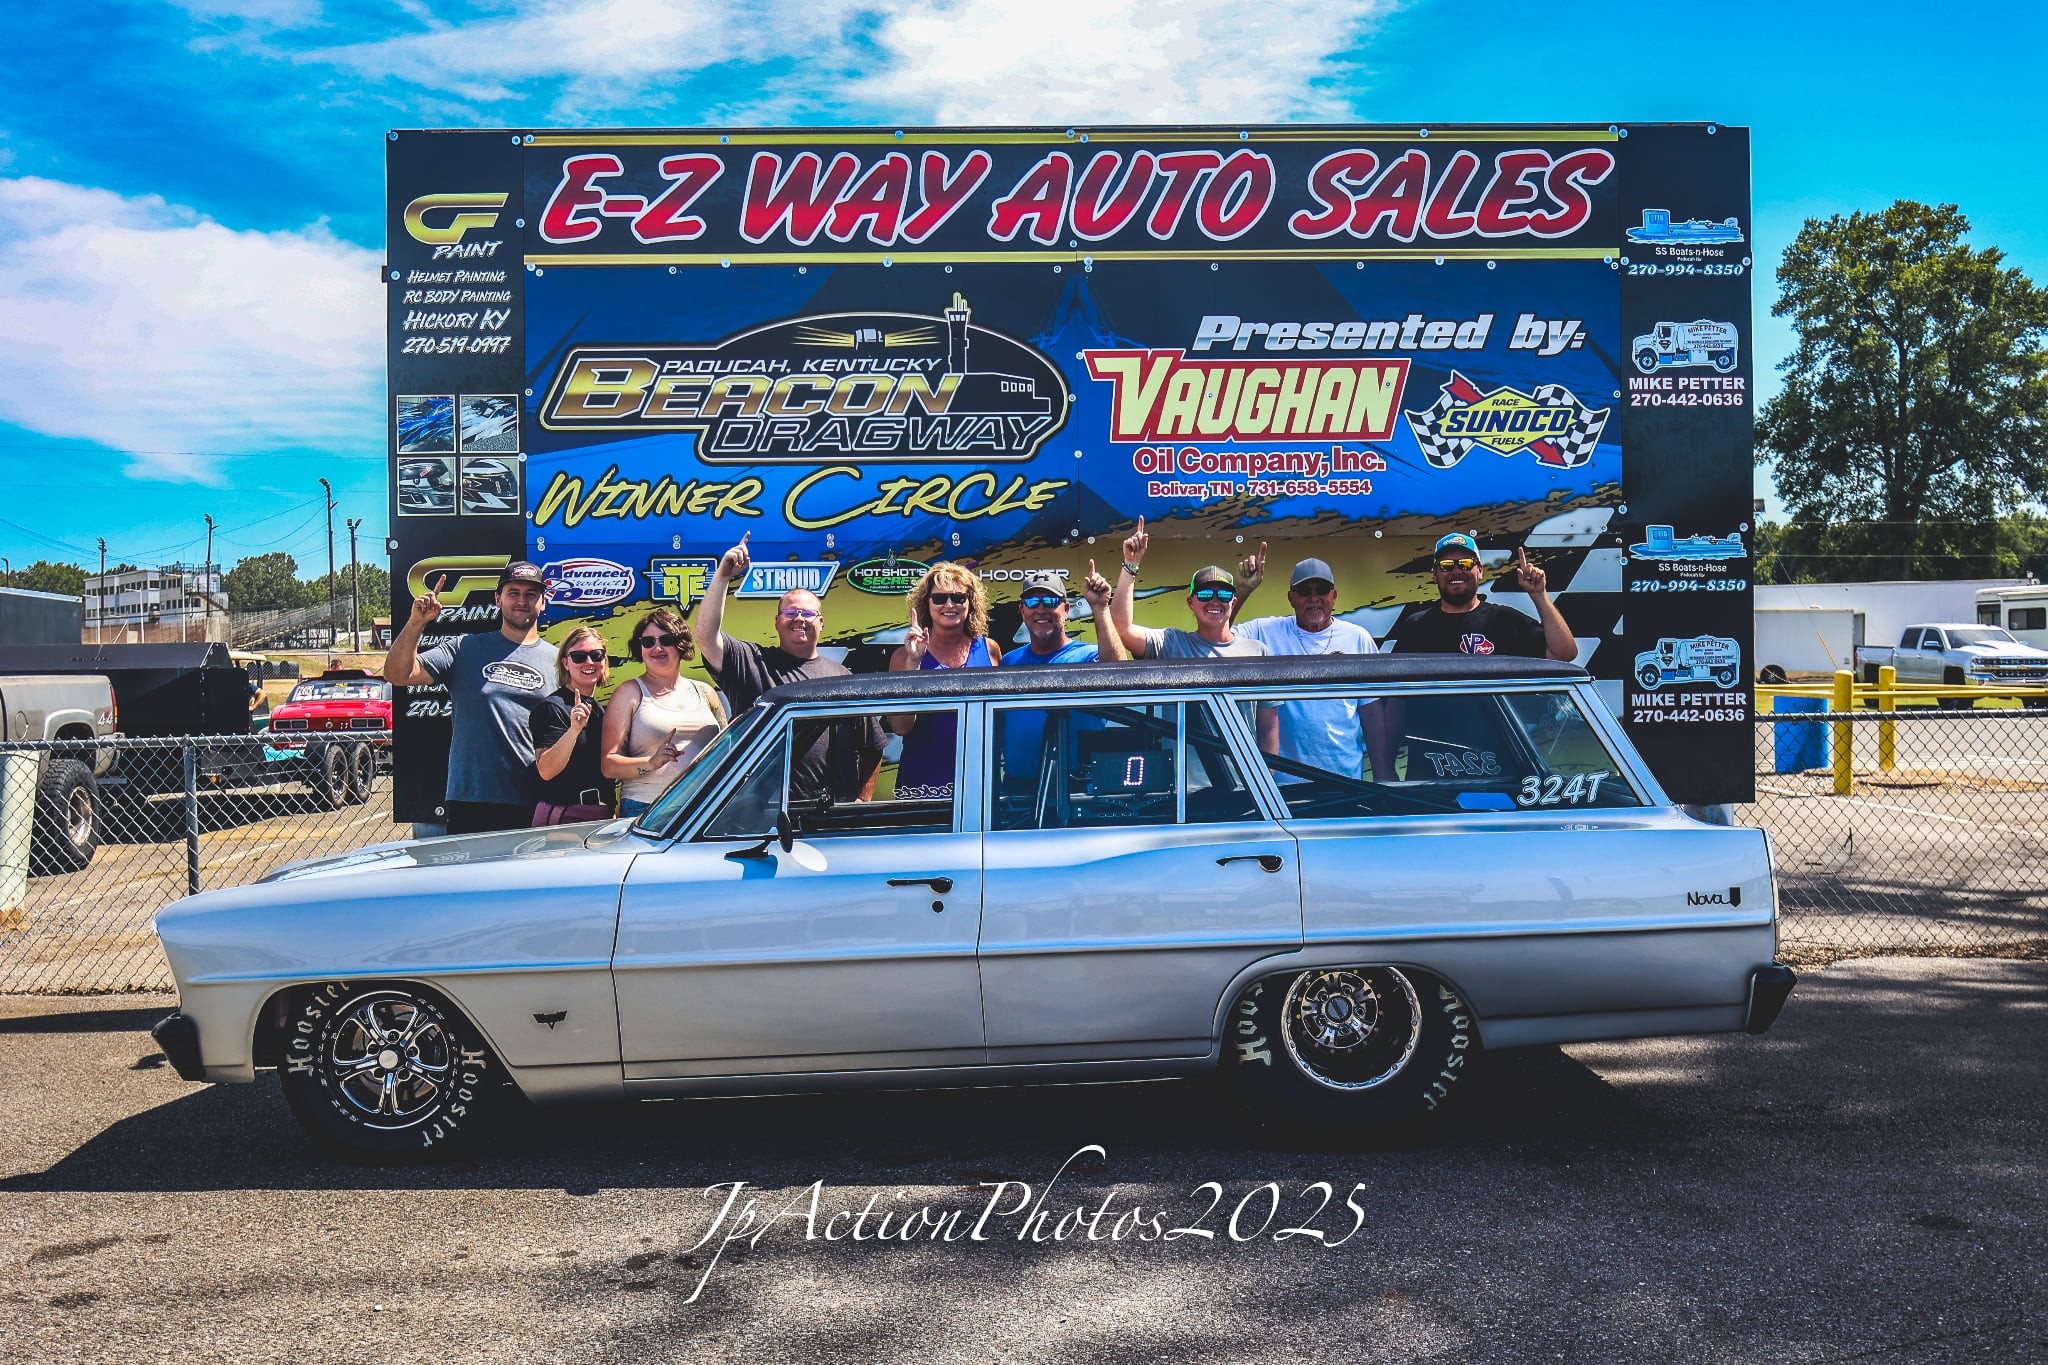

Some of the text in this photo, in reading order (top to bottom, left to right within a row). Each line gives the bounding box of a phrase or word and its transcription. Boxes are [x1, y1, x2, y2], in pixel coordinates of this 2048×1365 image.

[538, 148, 1615, 246] E-Z WAY AUTO SALES
[432, 241, 504, 260] PAINT
[1655, 247, 1724, 257] SS Boats-n-Hose
[1627, 263, 1744, 275] 270-994-8350
[403, 289, 422, 304] RC
[480, 307, 511, 331] KY
[1192, 313, 1587, 356] Presented by:
[401, 336, 512, 354] 270-519-0997
[662, 357, 941, 374] PADUCAH, KENTUCKY
[551, 357, 964, 419] BEACON
[1629, 377, 1745, 390] MIKE PETTER
[1090, 354, 1405, 437] VAUGHAN
[1492, 398, 1520, 406] RACE
[1630, 394, 1743, 406] 270-442-0636
[1446, 410, 1572, 433] SUNOCO
[710, 416, 1053, 453] DRAGWAY
[1491, 437, 1525, 445] FUELS
[1133, 446, 1386, 477] Oil Company, Inc.
[1148, 480, 1371, 498] Bolivar, TN 731-658-5554
[1658, 563, 1727, 573] SS Boats-n-Hose
[752, 568, 820, 591] STROUD
[1630, 580, 1746, 592] 270-994-8350
[436, 604, 501, 623] PAINT
[1462, 633, 1485, 654] VP
[1632, 693, 1746, 706] MIKE PETTER
[1634, 709, 1745, 723] 270-442-0636
[1517, 771, 1609, 806] 324T
[422, 1045, 488, 1148] Hoosier
